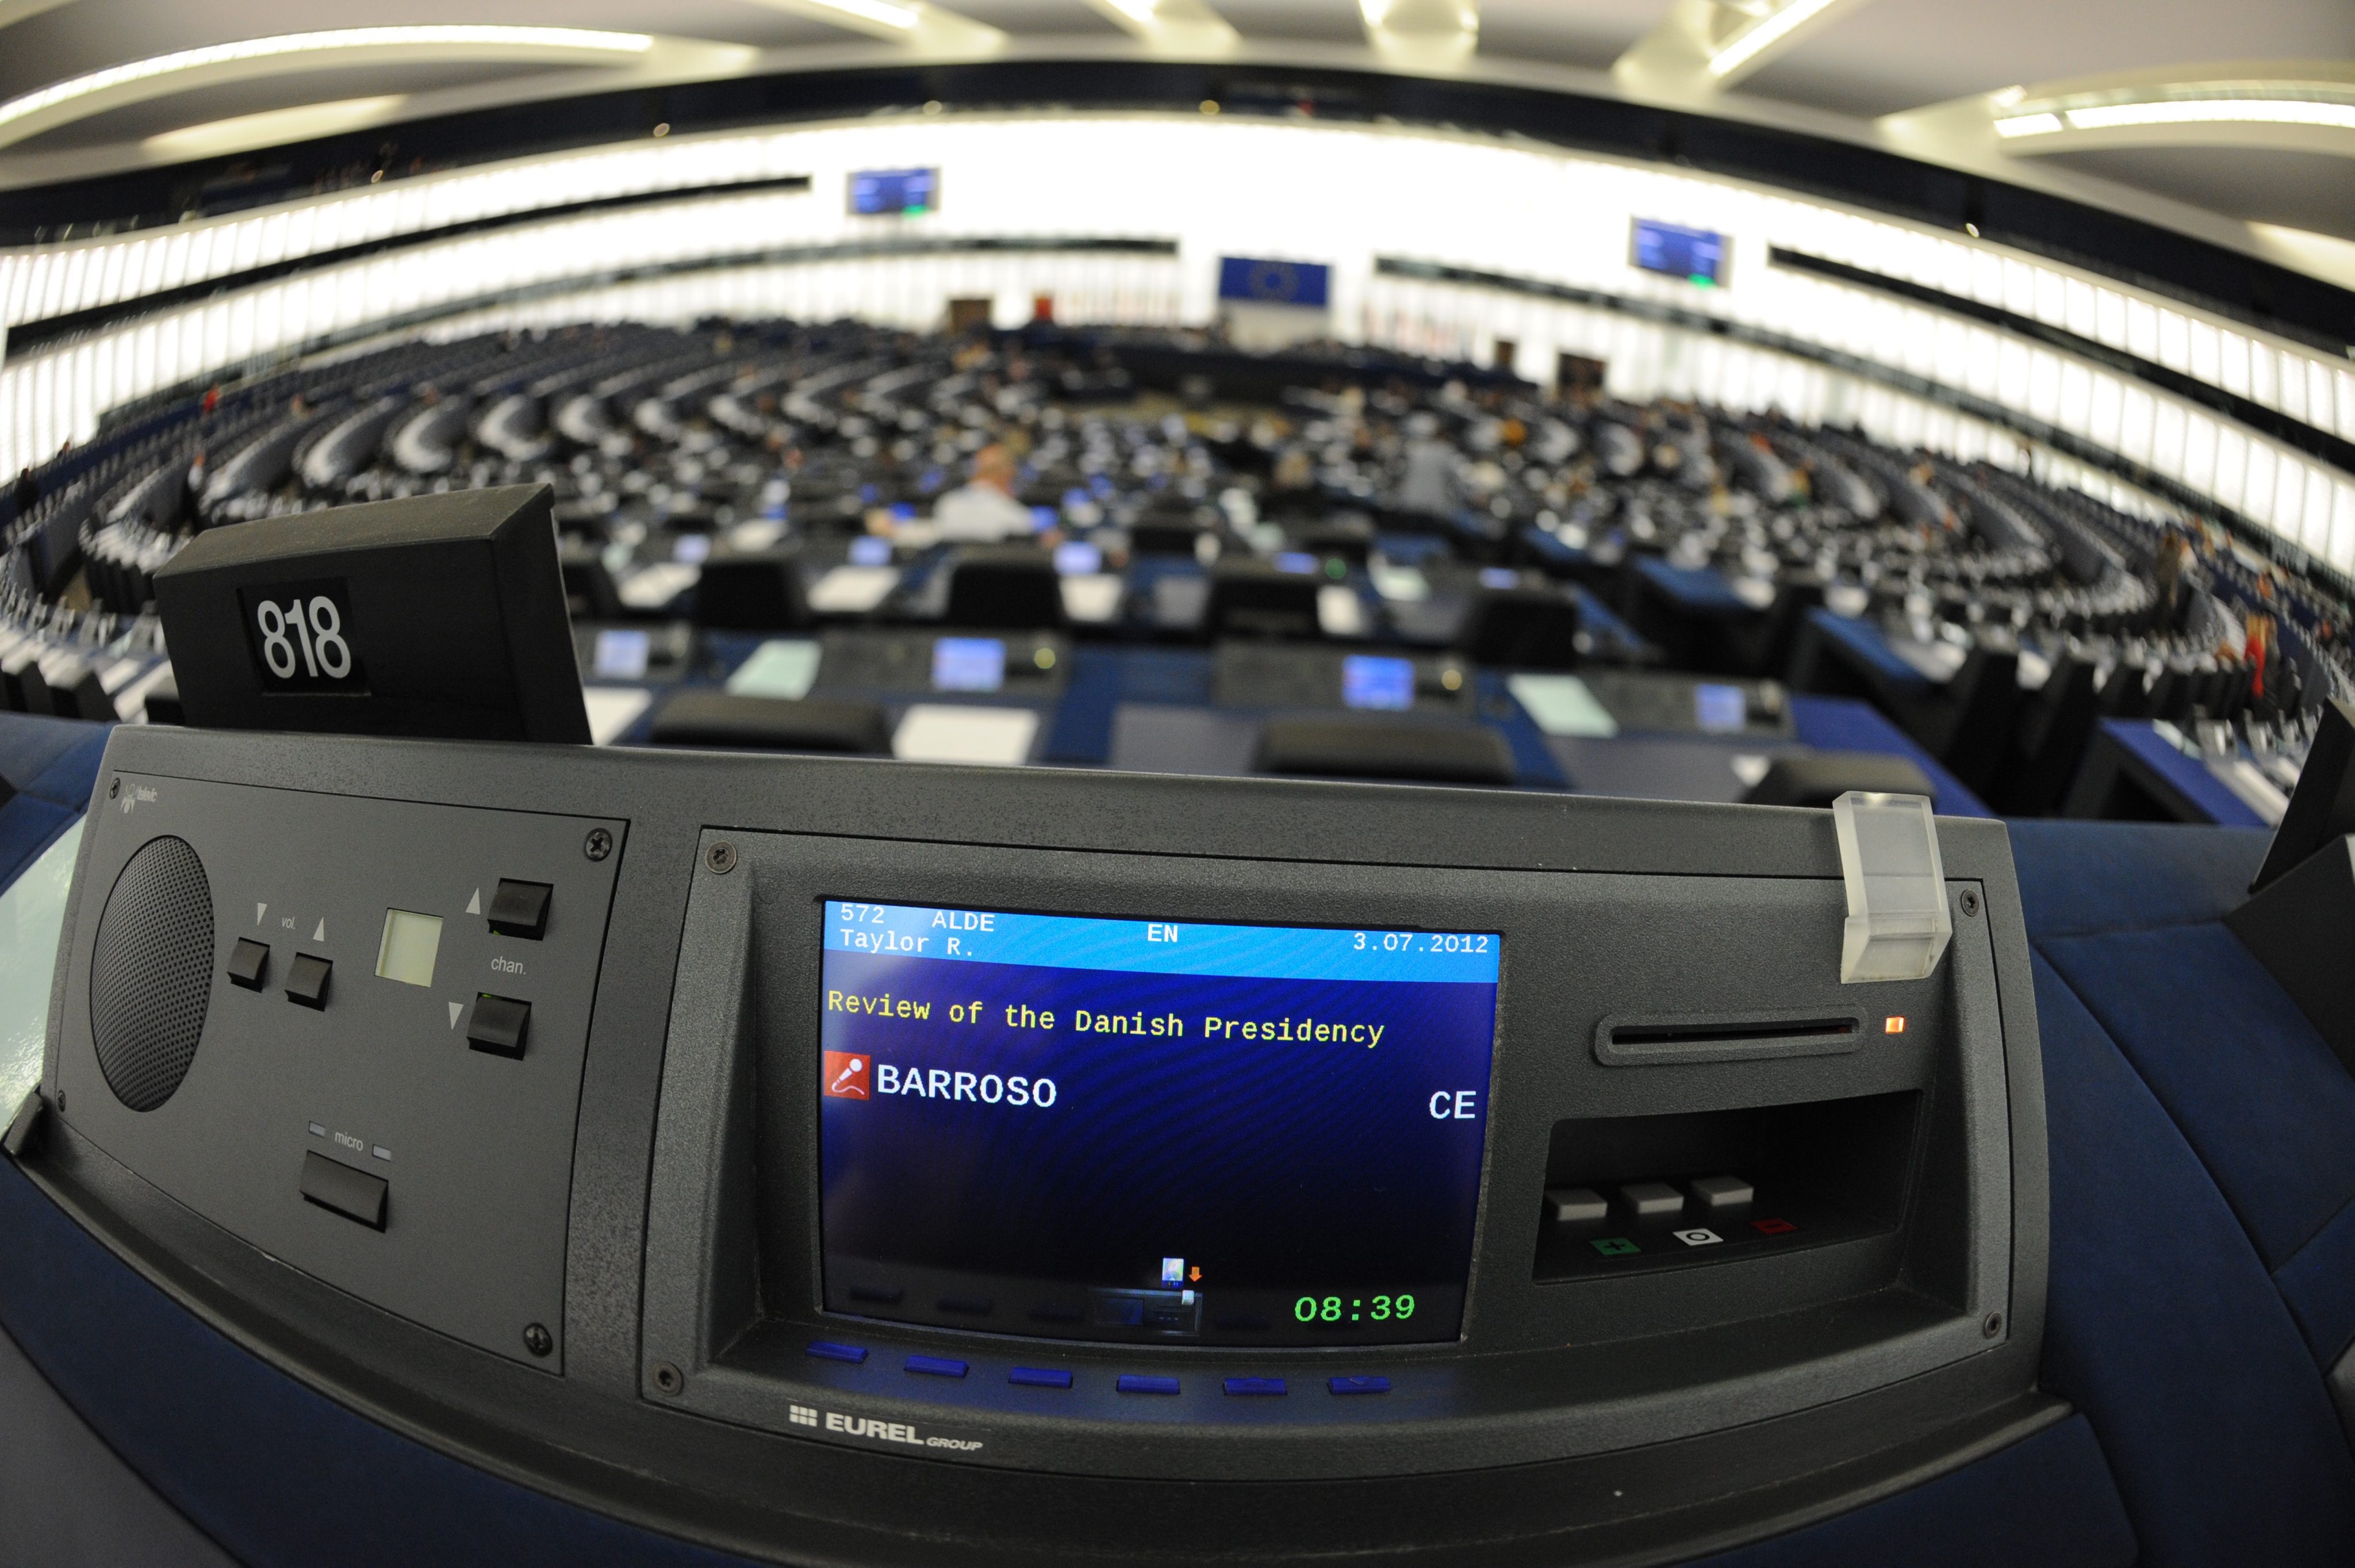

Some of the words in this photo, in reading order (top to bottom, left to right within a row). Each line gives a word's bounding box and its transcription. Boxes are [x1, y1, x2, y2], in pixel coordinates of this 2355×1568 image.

[258, 596, 351, 678] 818
[281, 916, 296, 930] vol.
[840, 903, 885, 924] 572
[932, 911, 995, 932] ALDE
[1147, 923, 1178, 943] EN
[1353, 932, 1489, 953] 3.07.2012
[840, 928, 930, 953] Taylor
[947, 938, 973, 956] R.
[490, 956, 527, 975] chan.
[828, 990, 931, 1020] Review
[949, 1001, 983, 1023] of
[1006, 1005, 1055, 1029] the
[1075, 1010, 1184, 1037] Danish
[1204, 1016, 1385, 1048] Presidency
[877, 1064, 1057, 1108] BARROSO
[1429, 1090, 1476, 1120] CE
[335, 1131, 363, 1151] micro
[1295, 1294, 1415, 1322] 08:39
[826, 1412, 925, 1445] EUREL
[926, 1437, 984, 1451] GROUP
